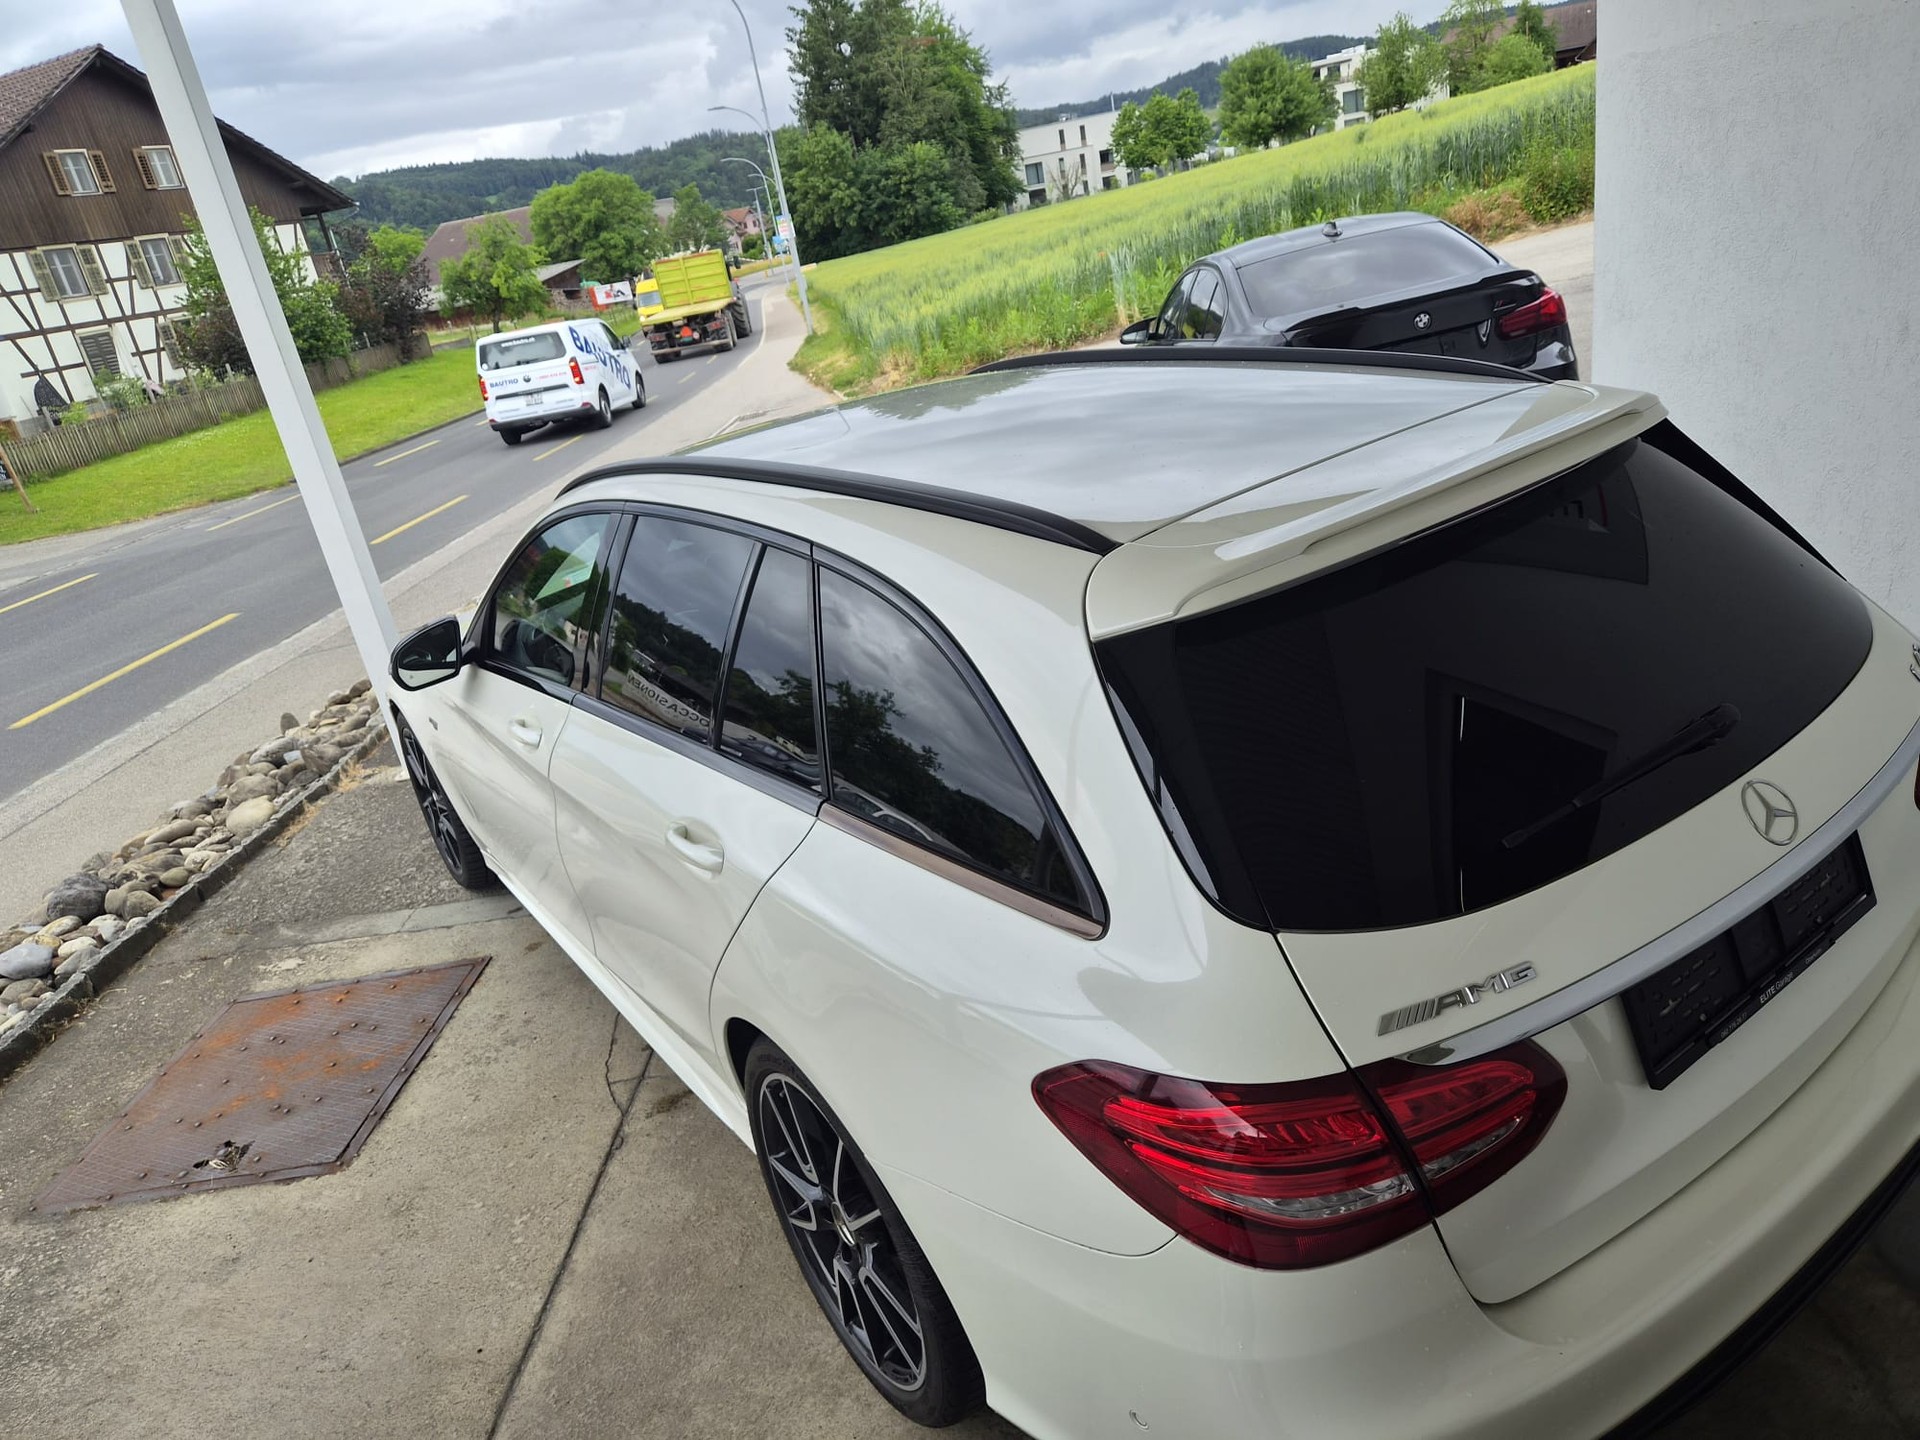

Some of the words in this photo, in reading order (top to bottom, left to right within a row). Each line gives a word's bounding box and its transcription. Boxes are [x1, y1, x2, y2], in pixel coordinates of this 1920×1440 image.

[489, 378, 519, 389] BAUTRO
[569, 326, 631, 389] BAUTRO
[1431, 960, 1538, 1020] AMG
